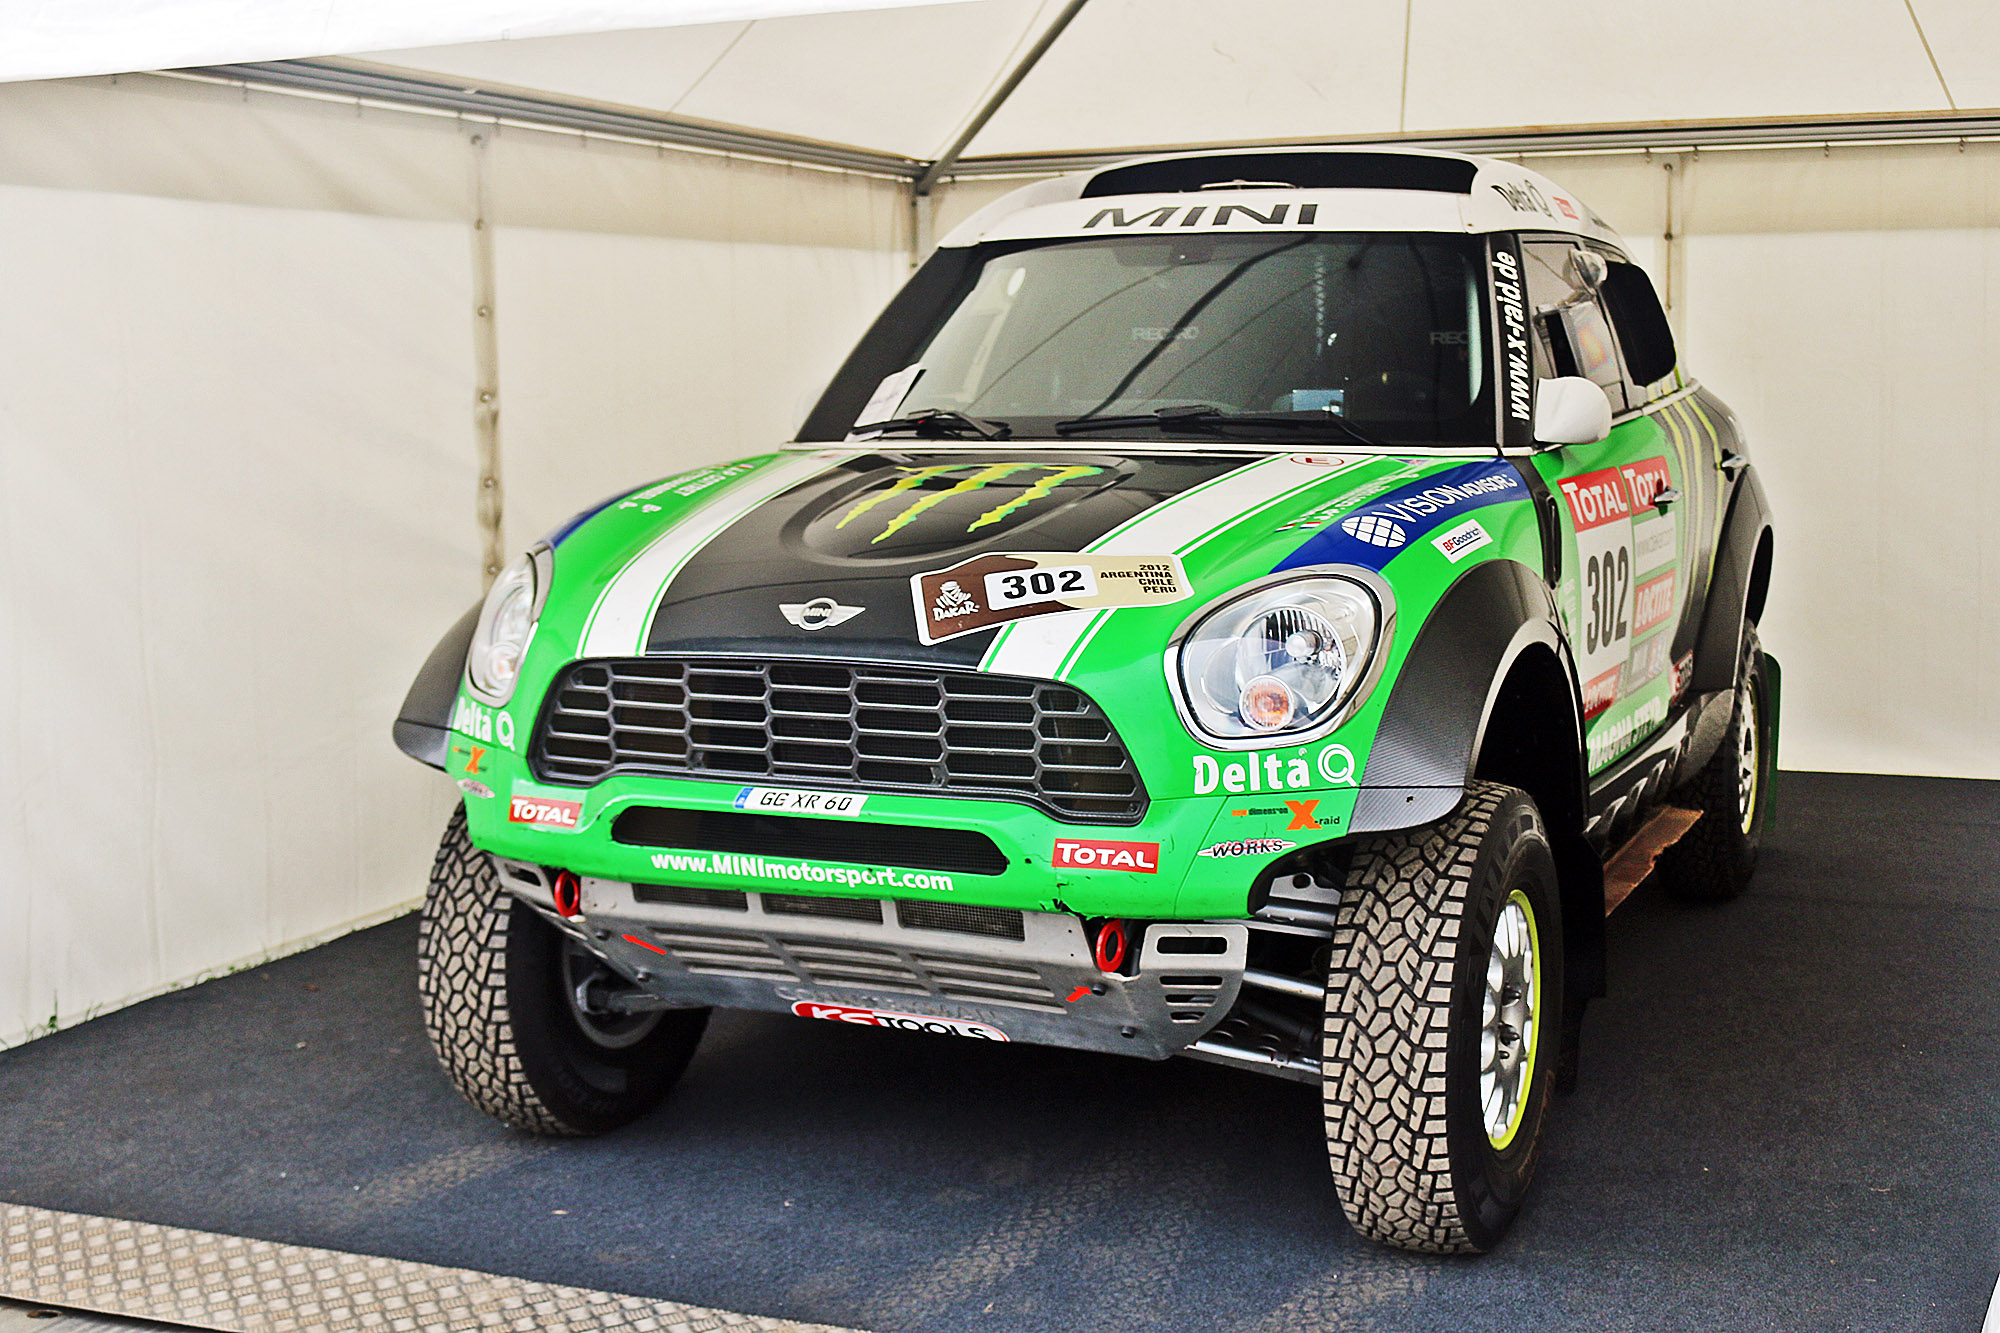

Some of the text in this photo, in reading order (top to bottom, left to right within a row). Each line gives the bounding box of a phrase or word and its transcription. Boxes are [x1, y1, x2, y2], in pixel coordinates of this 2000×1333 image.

[1083, 204, 1318, 228] MINI
[1491, 251, 1530, 421] www.x-raid.de
[1371, 484, 1464, 523] VISION
[1560, 481, 1629, 525] TOTAL
[1002, 570, 1086, 600] 302
[1100, 571, 1174, 579] ARGENTINA
[1138, 578, 1176, 586] CHILE
[1143, 586, 1178, 594] PERU
[1587, 546, 1629, 655] 302
[803, 607, 832, 617] MINI
[1192, 743, 1358, 795] Delta Q
[511, 798, 576, 825] TOTAL
[759, 791, 790, 807] GG
[791, 793, 821, 810] XR
[824, 796, 853, 812] 60
[1056, 842, 1155, 869] TOTAL
[1212, 840, 1284, 857] WORKS
[650, 853, 954, 892] www.MINImotorsport.com
